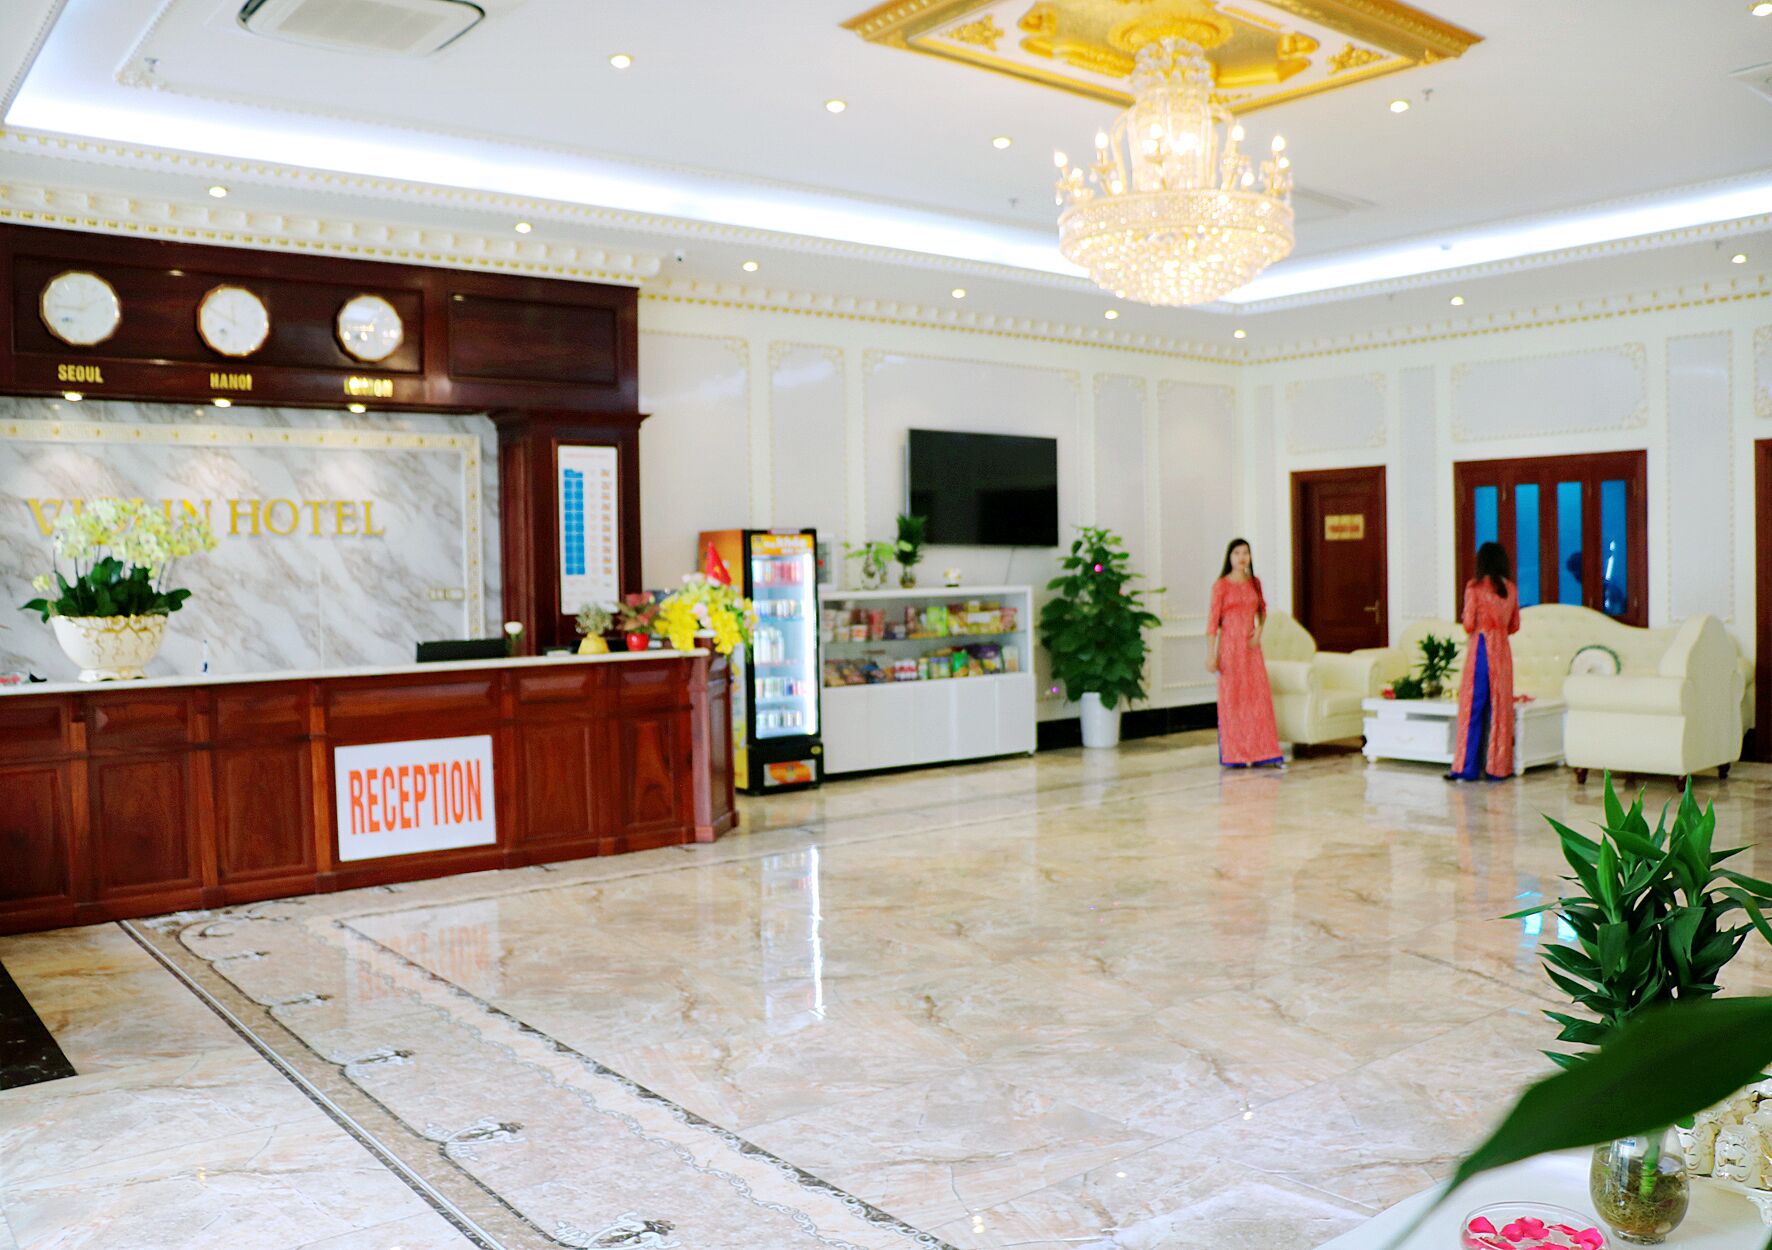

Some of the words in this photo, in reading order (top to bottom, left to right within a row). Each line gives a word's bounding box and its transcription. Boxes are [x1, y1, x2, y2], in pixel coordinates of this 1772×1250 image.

[58, 364, 103, 383] SEOUL
[210, 373, 252, 390] HANOI
[227, 497, 385, 537] HOTEL
[348, 759, 483, 835] RECEPTION
